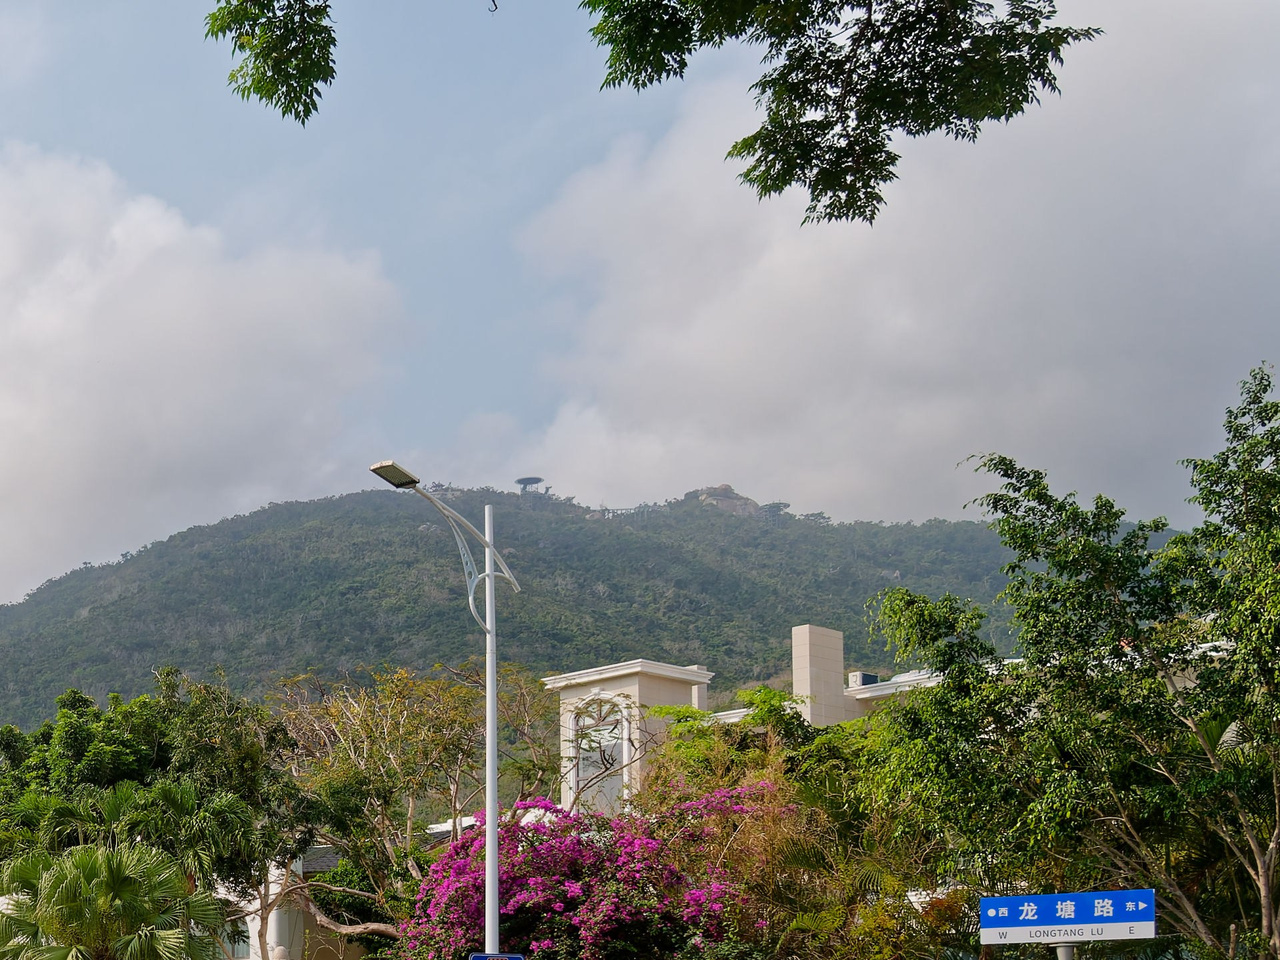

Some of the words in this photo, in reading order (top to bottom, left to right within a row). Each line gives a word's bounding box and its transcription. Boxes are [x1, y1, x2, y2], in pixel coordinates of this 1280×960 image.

[998, 907, 1008, 917] 西
[1018, 899, 1114, 920] 龙塘路
[1125, 902, 1136, 911] 东
[998, 931, 1008, 939] W
[1029, 928, 1084, 938] LONGTANG
[1091, 927, 1104, 936] LU
[1128, 926, 1135, 935] E
